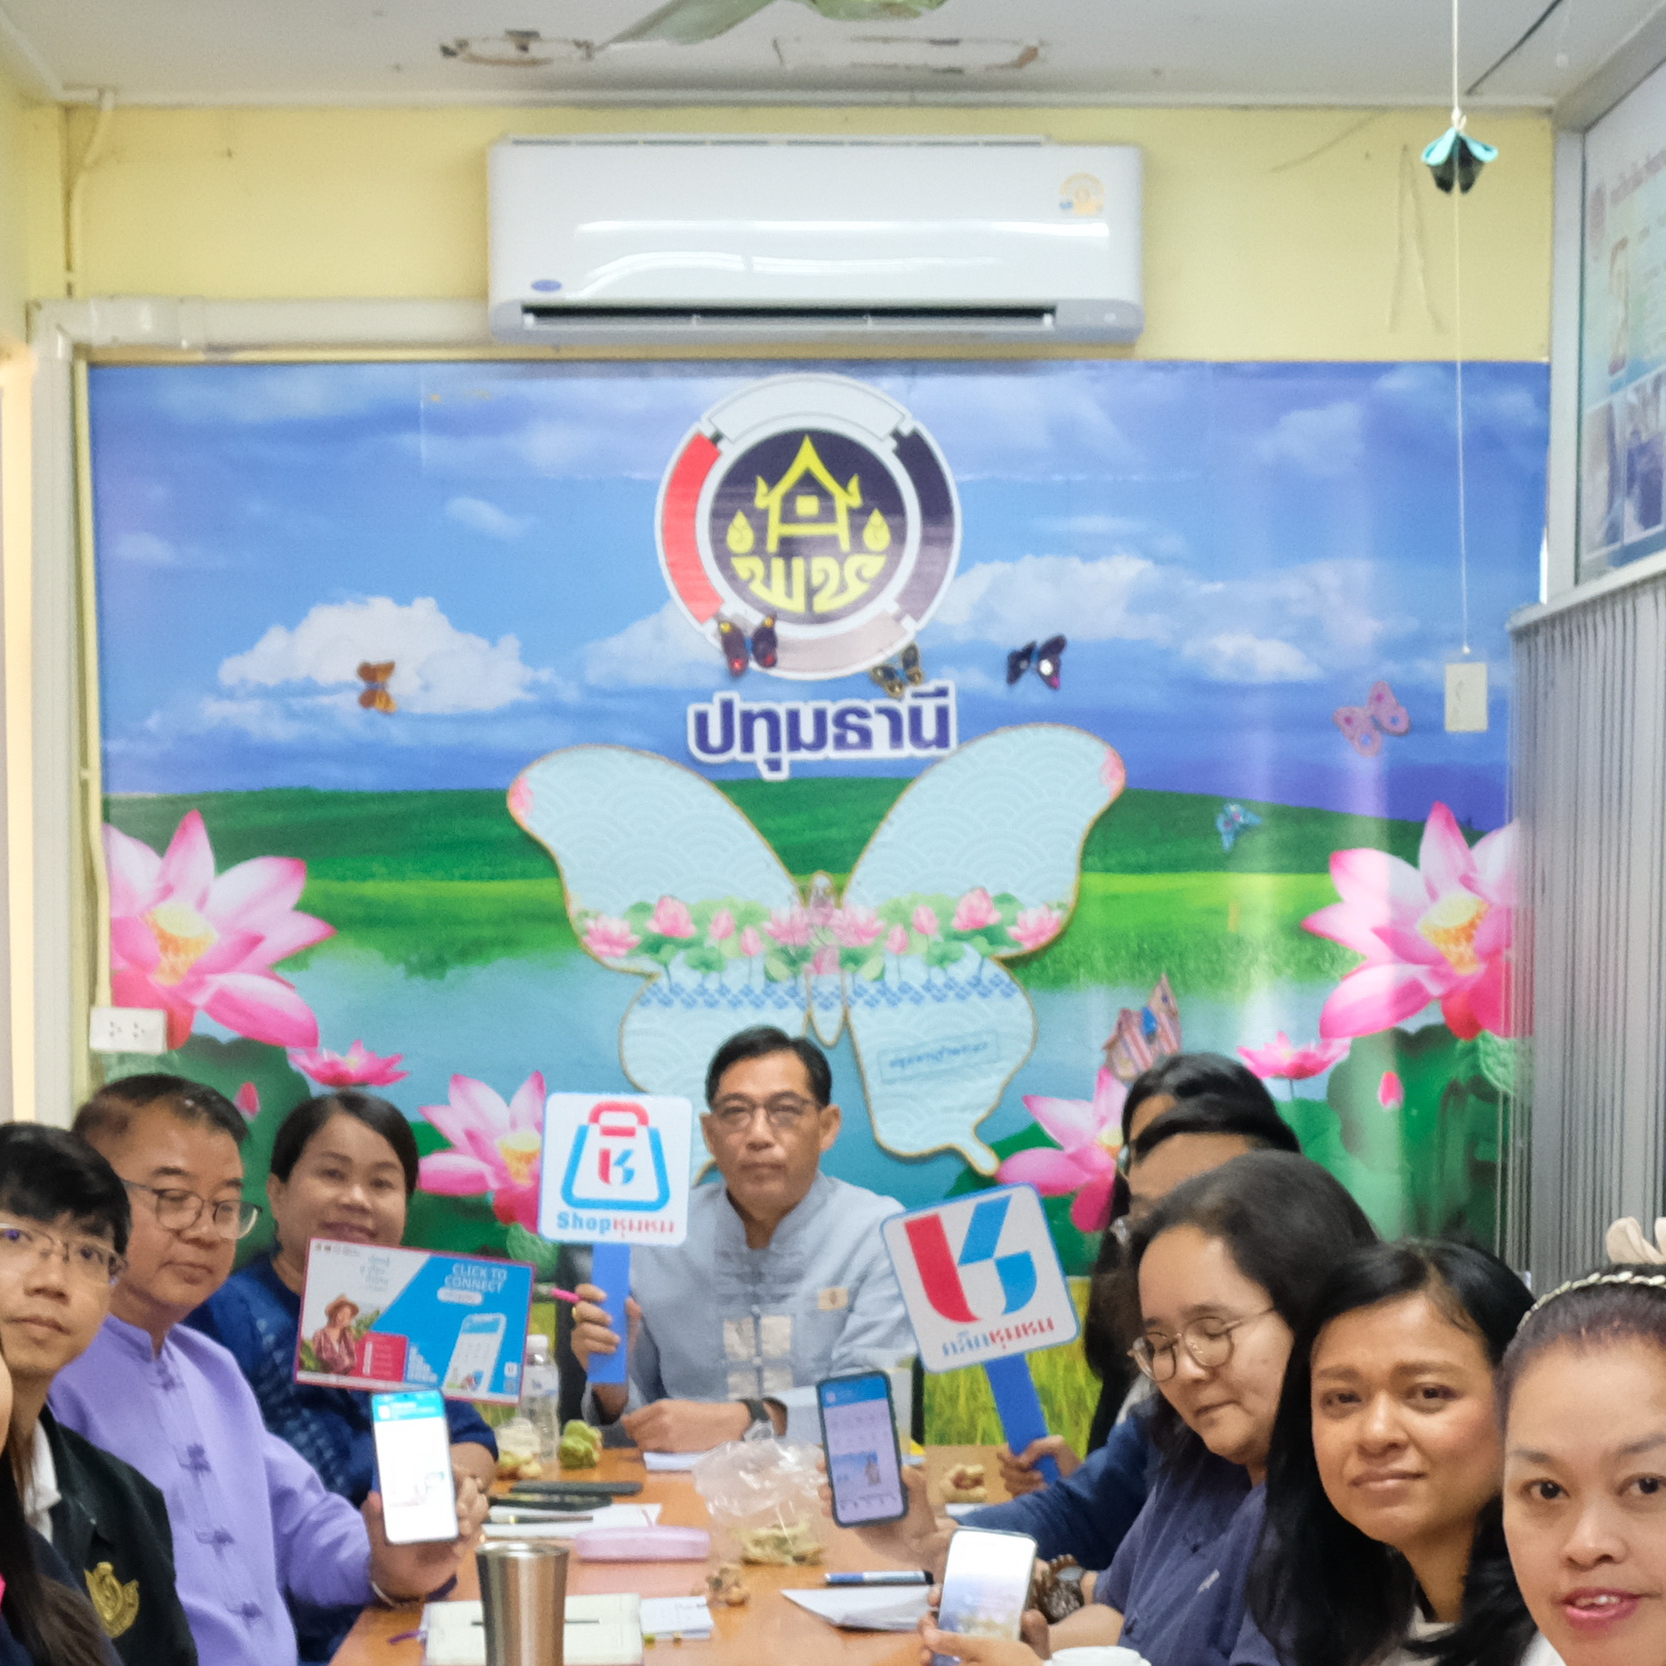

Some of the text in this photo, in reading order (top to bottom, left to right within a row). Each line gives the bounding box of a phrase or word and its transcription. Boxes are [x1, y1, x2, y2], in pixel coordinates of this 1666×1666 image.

[694, 687, 951, 773] ปทุมธานี
[452, 1262, 508, 1282] CLICK TO
[444, 1274, 504, 1294] CONNECT
